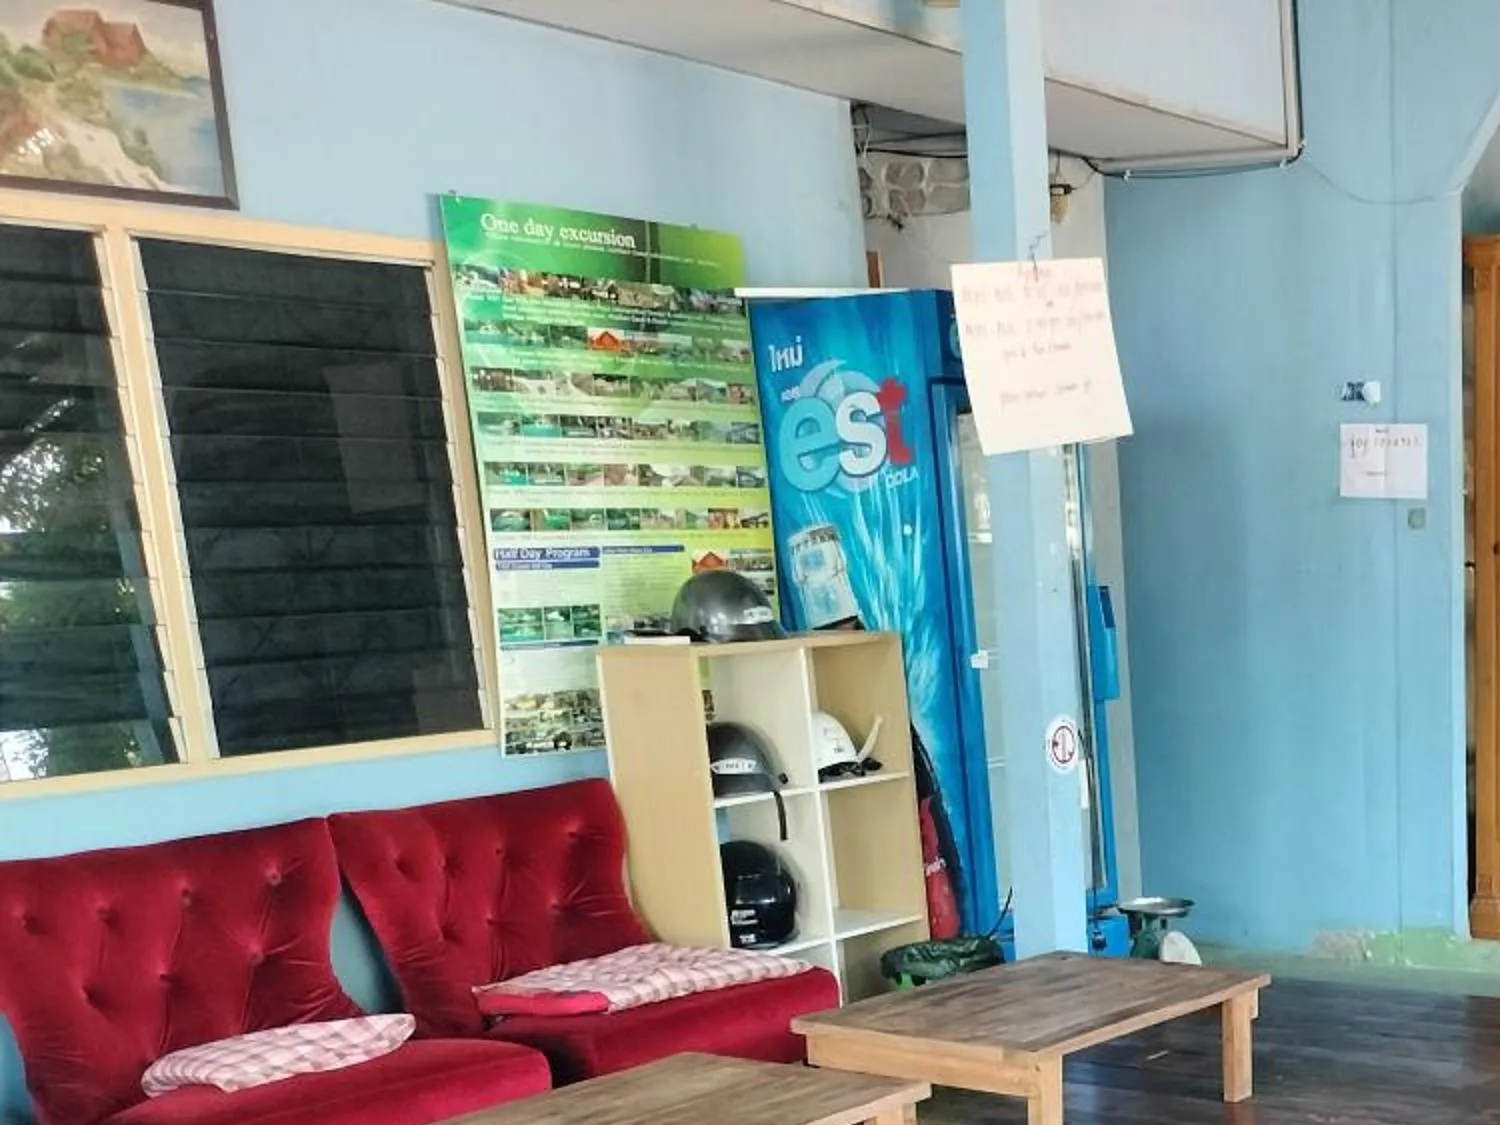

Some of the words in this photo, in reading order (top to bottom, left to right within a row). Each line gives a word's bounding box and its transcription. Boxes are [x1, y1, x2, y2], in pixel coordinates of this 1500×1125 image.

[480, 213, 519, 233] One
[524, 217, 554, 240] day
[559, 227, 636, 248] excursion
[768, 335, 803, 373] ใหม่
[779, 376, 914, 493] est
[521, 547, 542, 560] Day
[545, 547, 590, 560] Program
